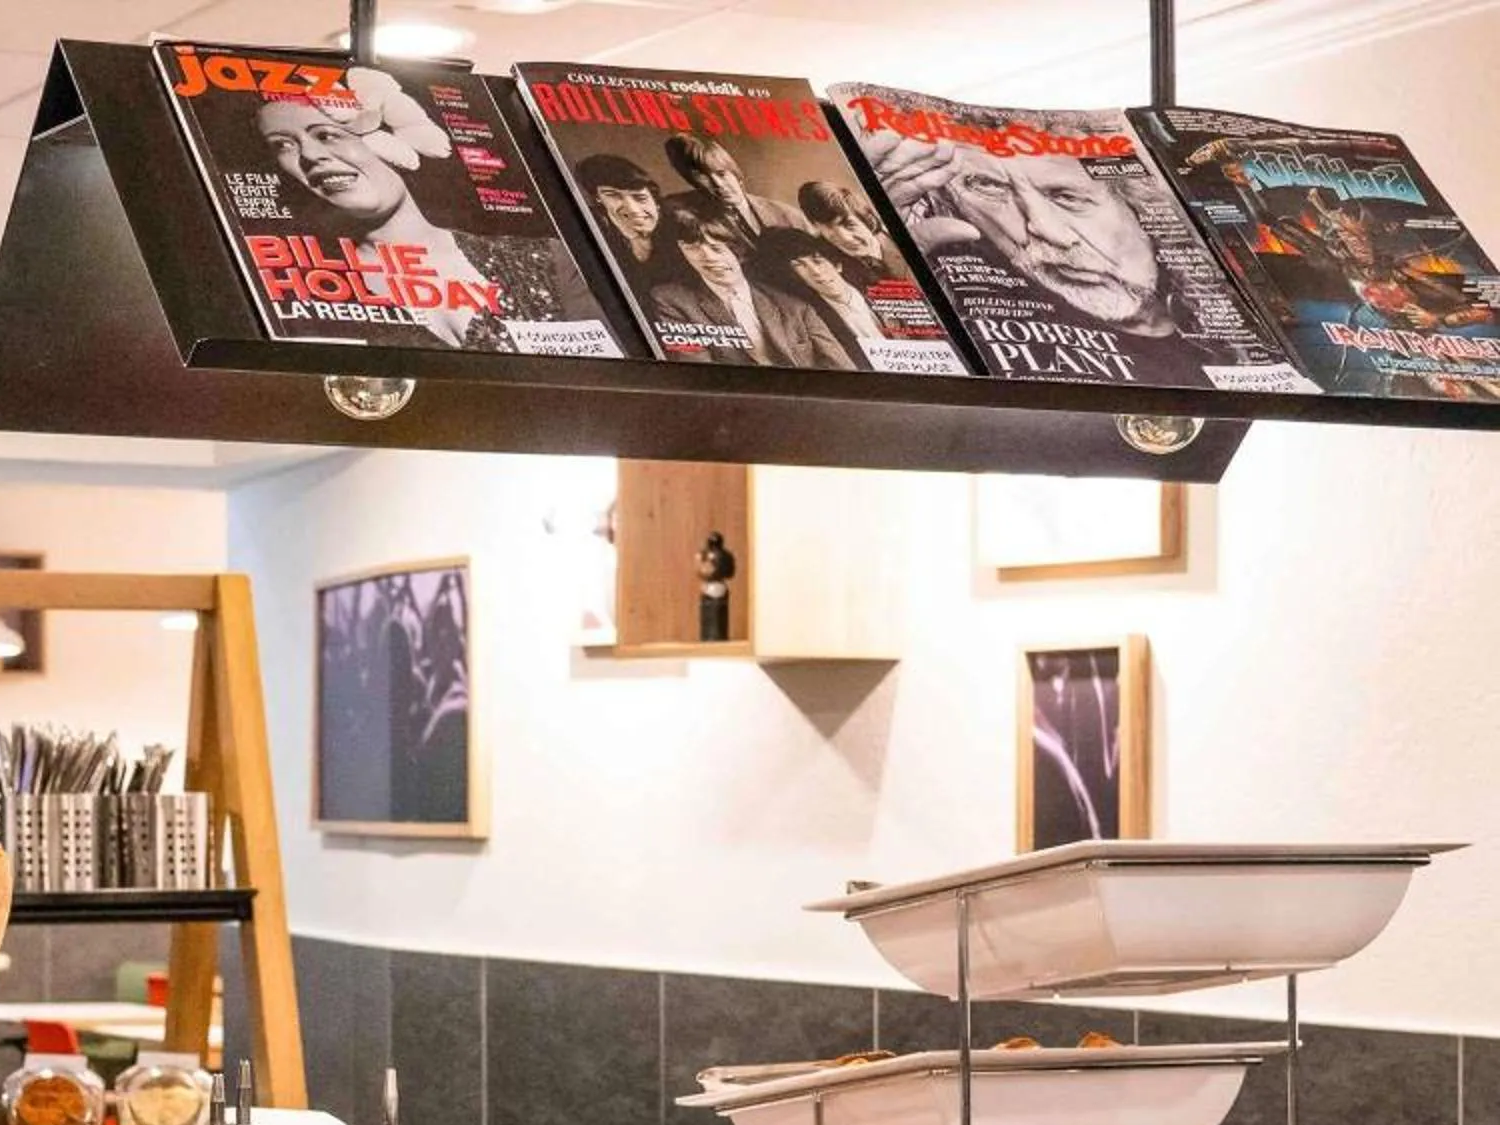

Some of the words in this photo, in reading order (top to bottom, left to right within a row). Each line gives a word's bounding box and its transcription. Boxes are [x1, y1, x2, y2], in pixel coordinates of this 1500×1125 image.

[173, 46, 357, 99] jazz
[567, 73, 669, 91] COLLECTION
[532, 83, 693, 132] ROLLING
[691, 95, 830, 143] STONES
[224, 173, 244, 185] LE
[245, 173, 281, 185] FILM
[244, 236, 438, 276] BILLIE
[260, 267, 504, 317] HOLIDAY
[273, 301, 307, 319] LA
[313, 302, 430, 325] REBELLE
[654, 321, 748, 337] L'HISTOIRE
[975, 318, 1120, 353] ROBERT
[987, 343, 1137, 381] PLANT
